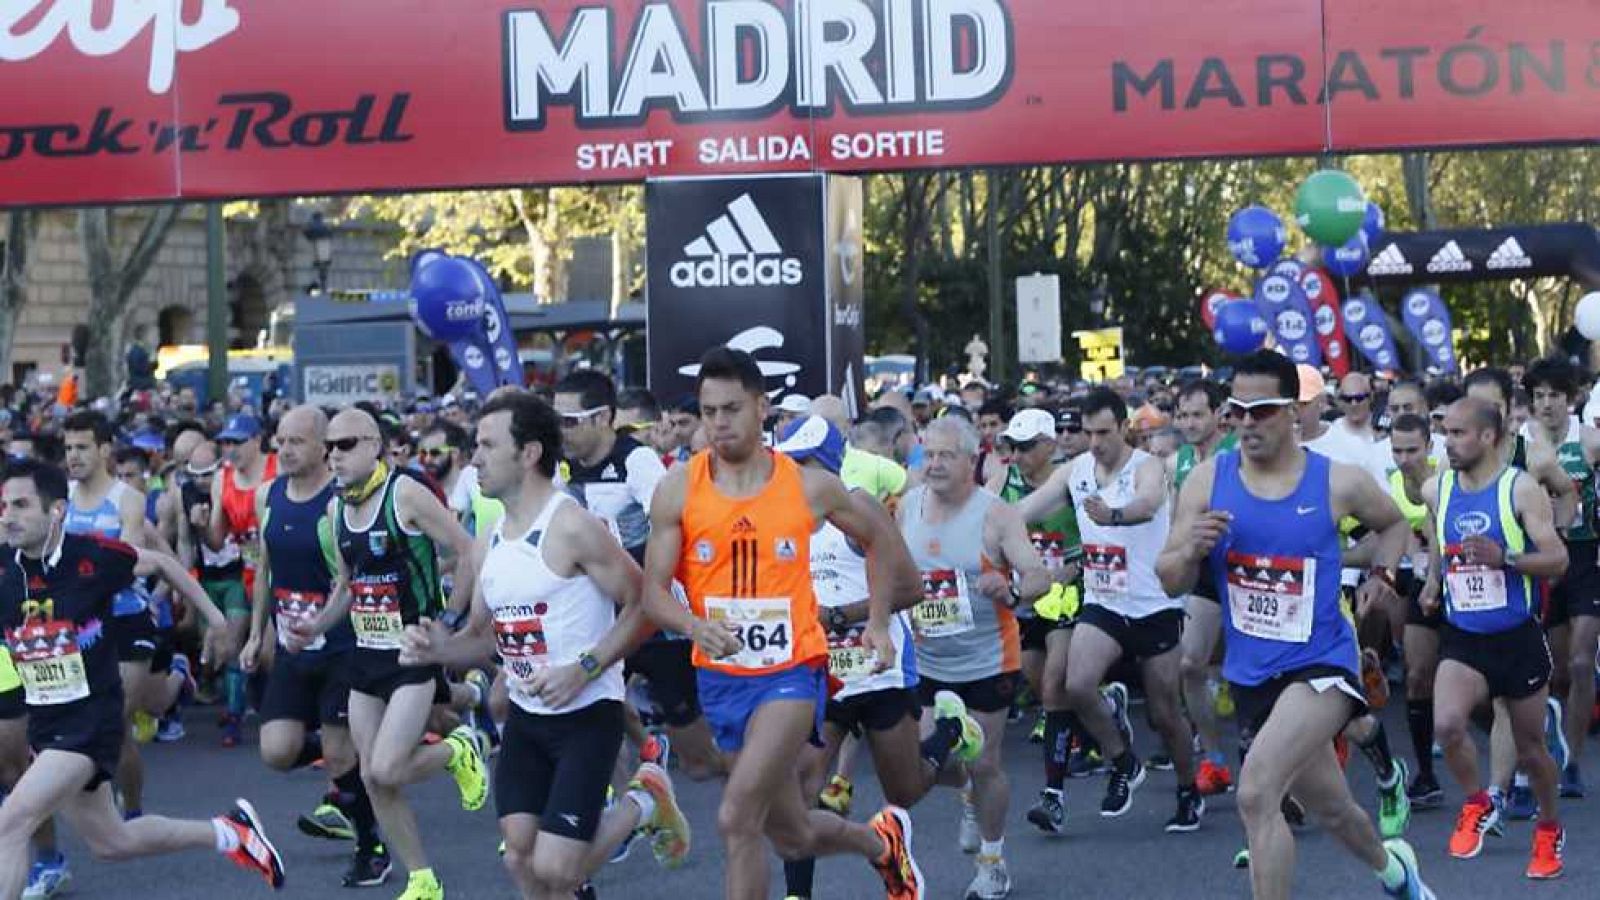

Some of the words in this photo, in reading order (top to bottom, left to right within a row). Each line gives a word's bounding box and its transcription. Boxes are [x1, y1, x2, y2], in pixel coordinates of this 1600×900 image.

[506, 0, 1013, 127] MADRID
[1112, 27, 1564, 112] MARATÓN
[218, 92, 414, 149] Roll
[576, 139, 673, 169] START
[699, 135, 811, 164] SALIDA
[831, 129, 945, 160] SORTIE
[670, 252, 802, 287] adidas
[1465, 576, 1485, 592] 122
[1248, 595, 1279, 617] 2029
